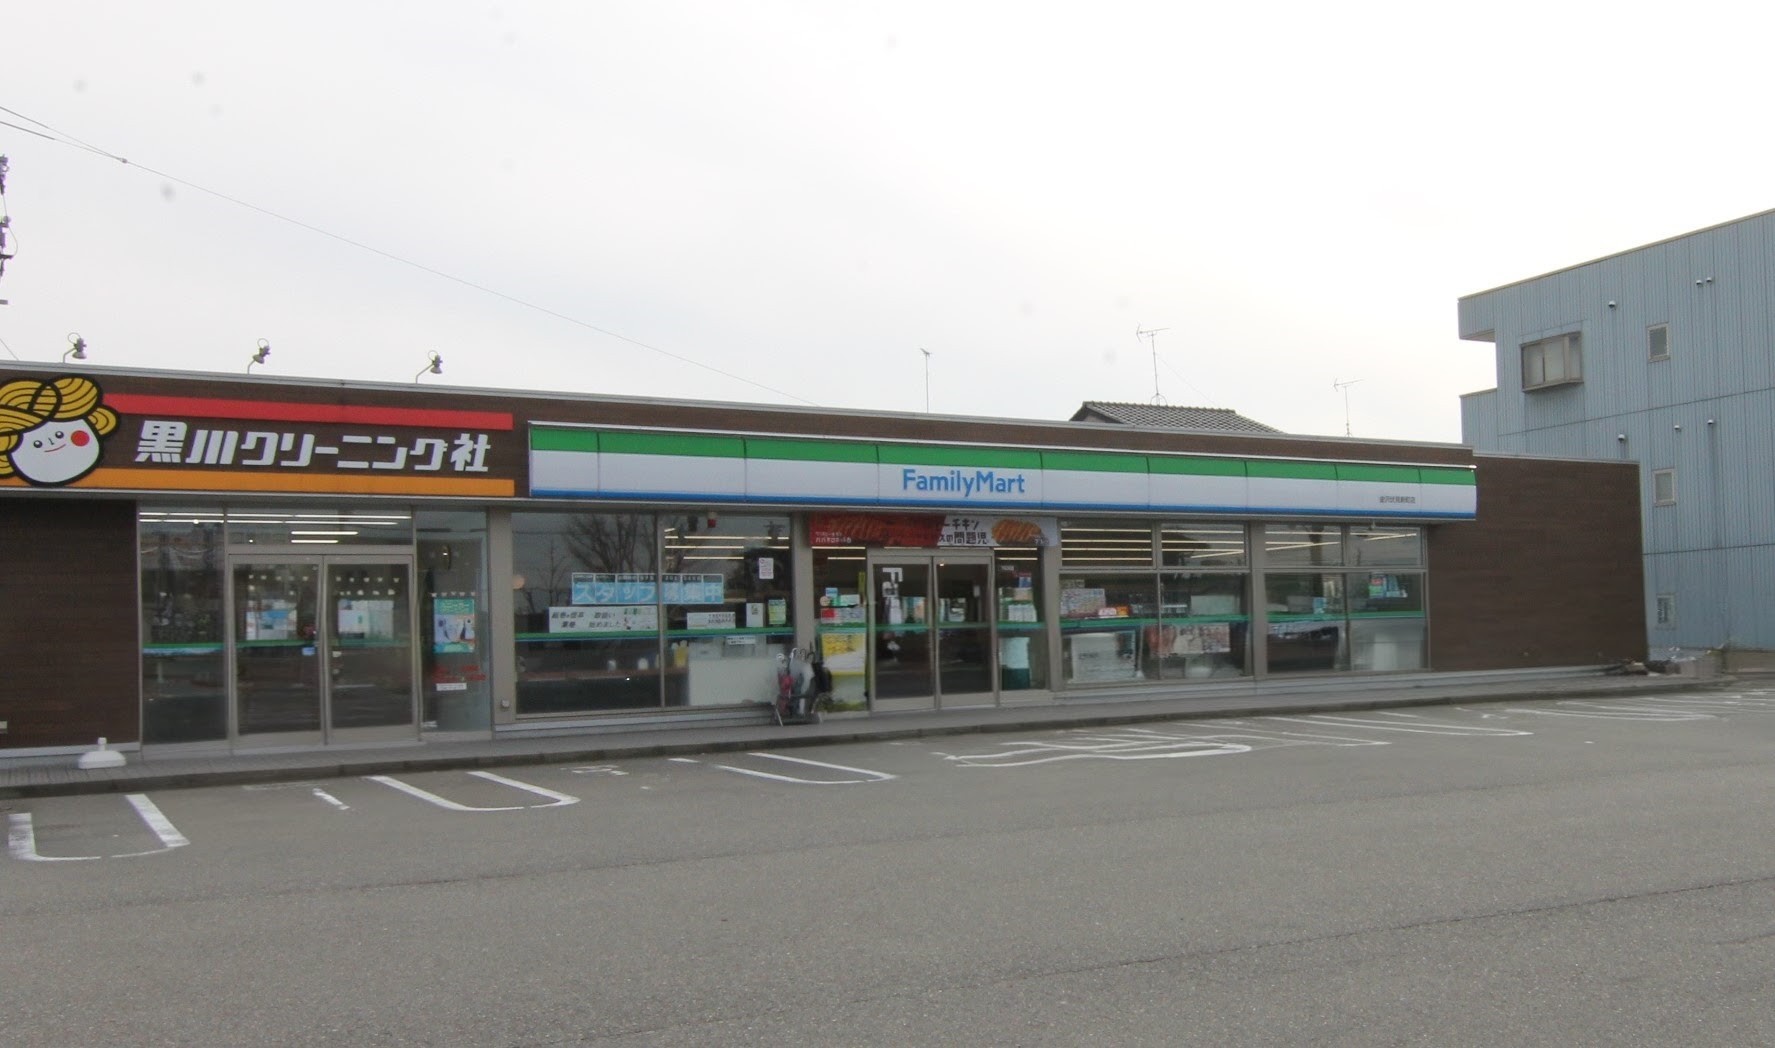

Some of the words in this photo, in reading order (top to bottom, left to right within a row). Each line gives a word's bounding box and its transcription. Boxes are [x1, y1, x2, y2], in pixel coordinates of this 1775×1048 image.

[135, 420, 490, 472] 黒川クリーニング社
[902, 468, 1024, 497] FamilyMart
